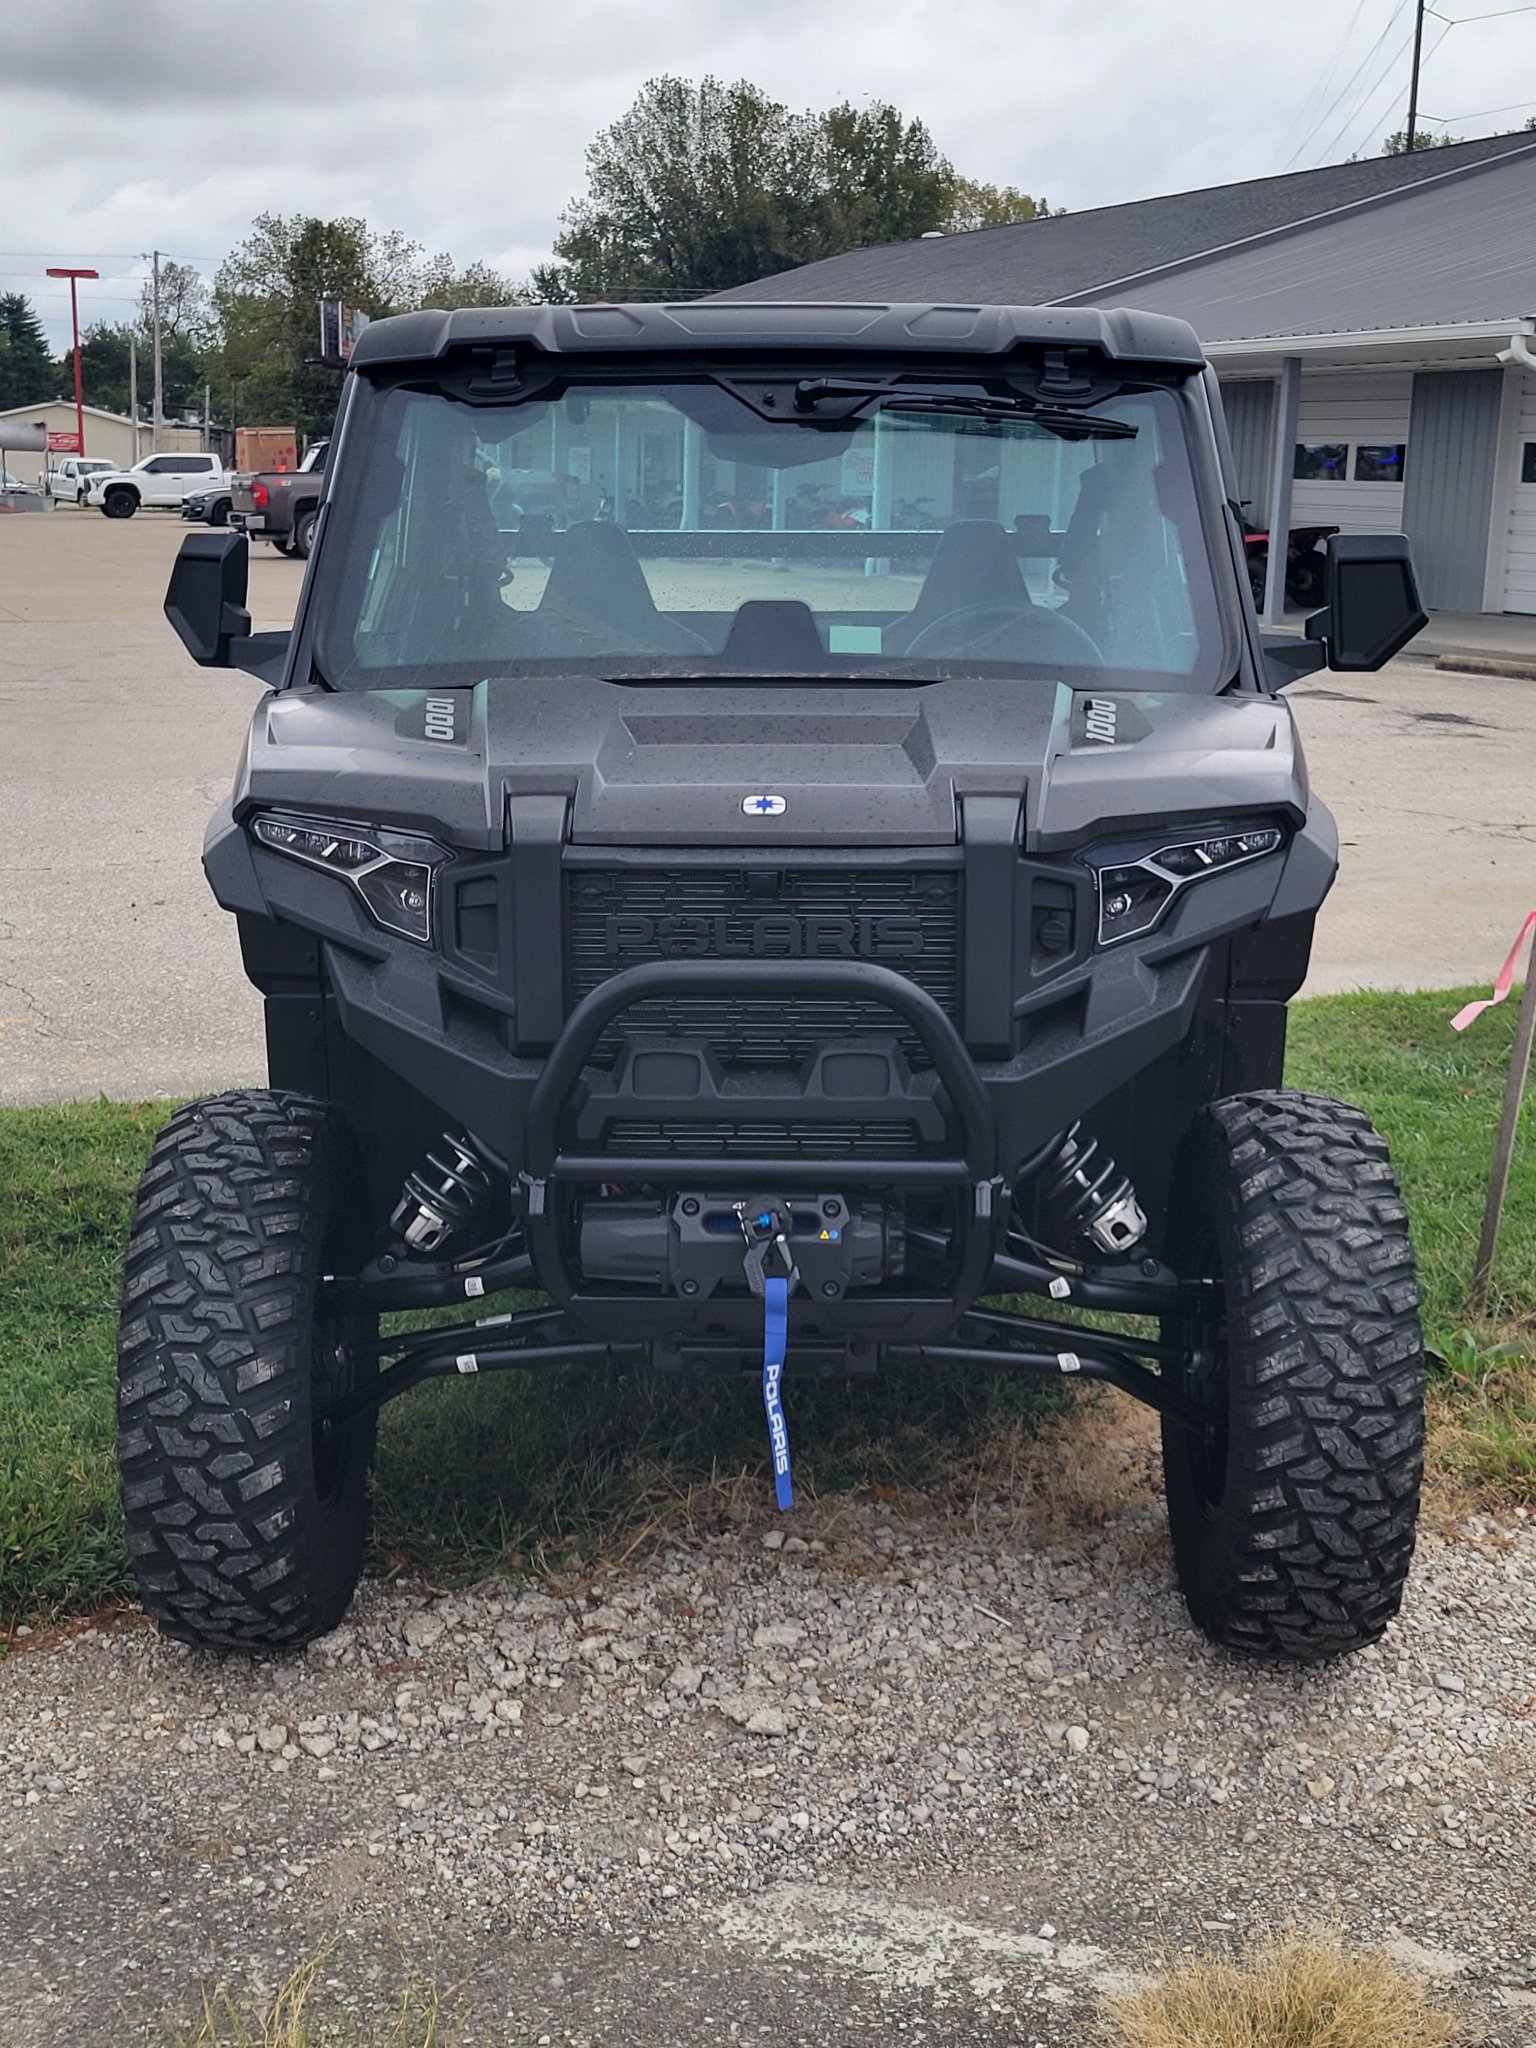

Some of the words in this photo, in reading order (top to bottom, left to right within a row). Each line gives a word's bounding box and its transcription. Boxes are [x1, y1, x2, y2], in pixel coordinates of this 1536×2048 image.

[425, 697, 455, 740] 1000
[1085, 699, 1116, 744] 1000
[605, 916, 925, 956] POLARIS
[766, 1364, 788, 1475] POLARIS
